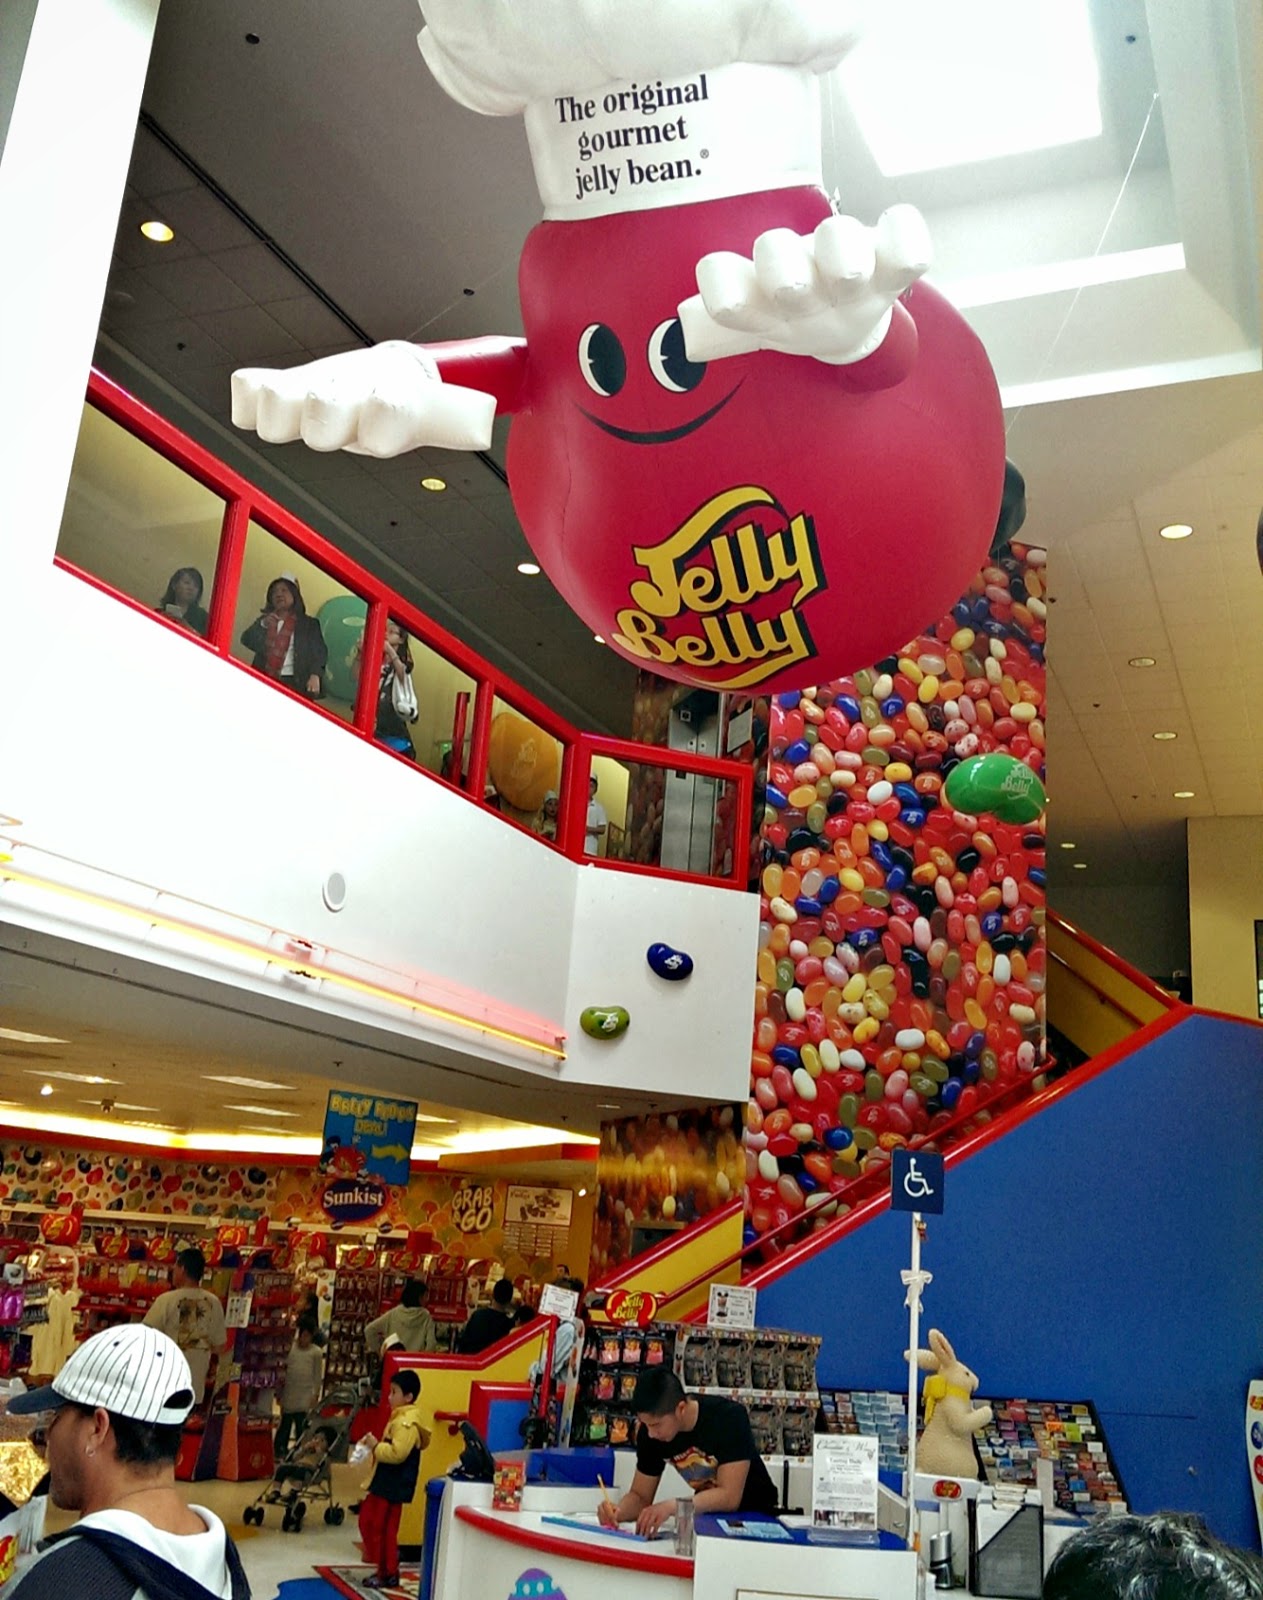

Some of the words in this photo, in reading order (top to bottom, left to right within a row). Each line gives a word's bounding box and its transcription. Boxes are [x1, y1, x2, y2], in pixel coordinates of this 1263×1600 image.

[555, 96, 596, 123] The
[603, 73, 709, 115] original
[577, 116, 689, 161] gourmet
[575, 163, 621, 200] jelly
[630, 484, 828, 619] Jelly
[610, 607, 819, 689] Belly
[323, 1186, 384, 1209] Sunkist
[452, 1186, 493, 1211] GRAB
[460, 1206, 492, 1232] GO
[612, 1304, 640, 1321] Belly
[622, 1290, 645, 1309] Jelly
